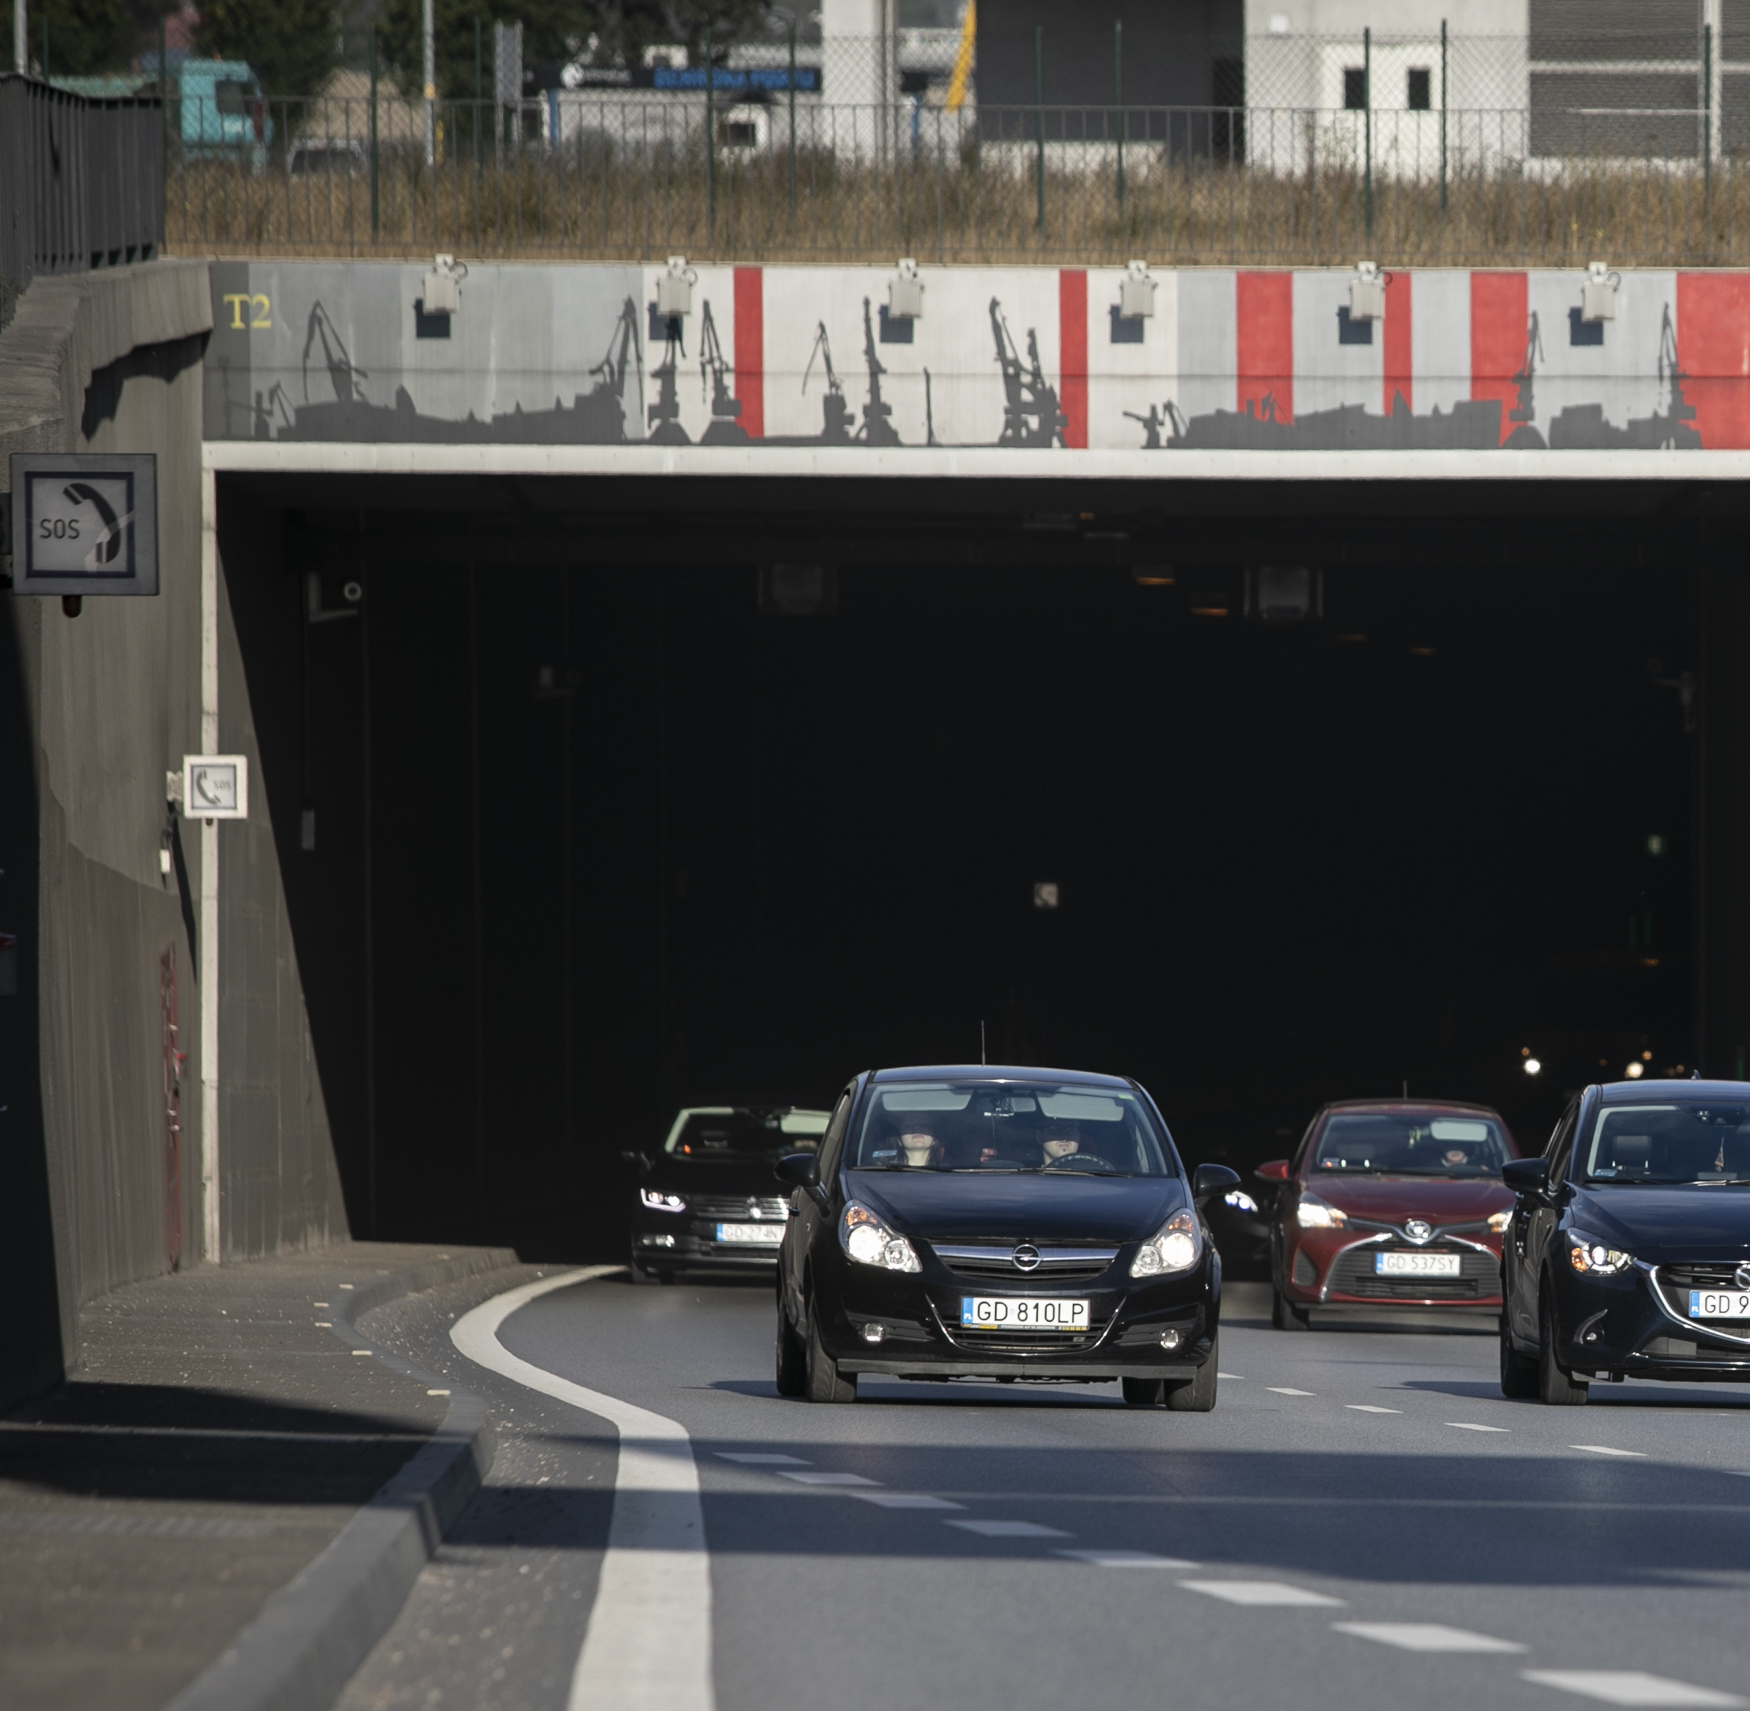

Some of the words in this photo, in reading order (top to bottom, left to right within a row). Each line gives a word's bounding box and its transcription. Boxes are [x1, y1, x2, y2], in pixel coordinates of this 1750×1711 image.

[223, 293, 272, 329] T2
[40, 518, 80, 540] SOS
[725, 1225, 743, 1238] GD
[1387, 1255, 1406, 1269] GD
[1411, 1256, 1455, 1270] 537SY
[977, 1301, 1008, 1322] GD
[1017, 1302, 1084, 1323] 810LP
[1704, 1295, 1730, 1313] GD
